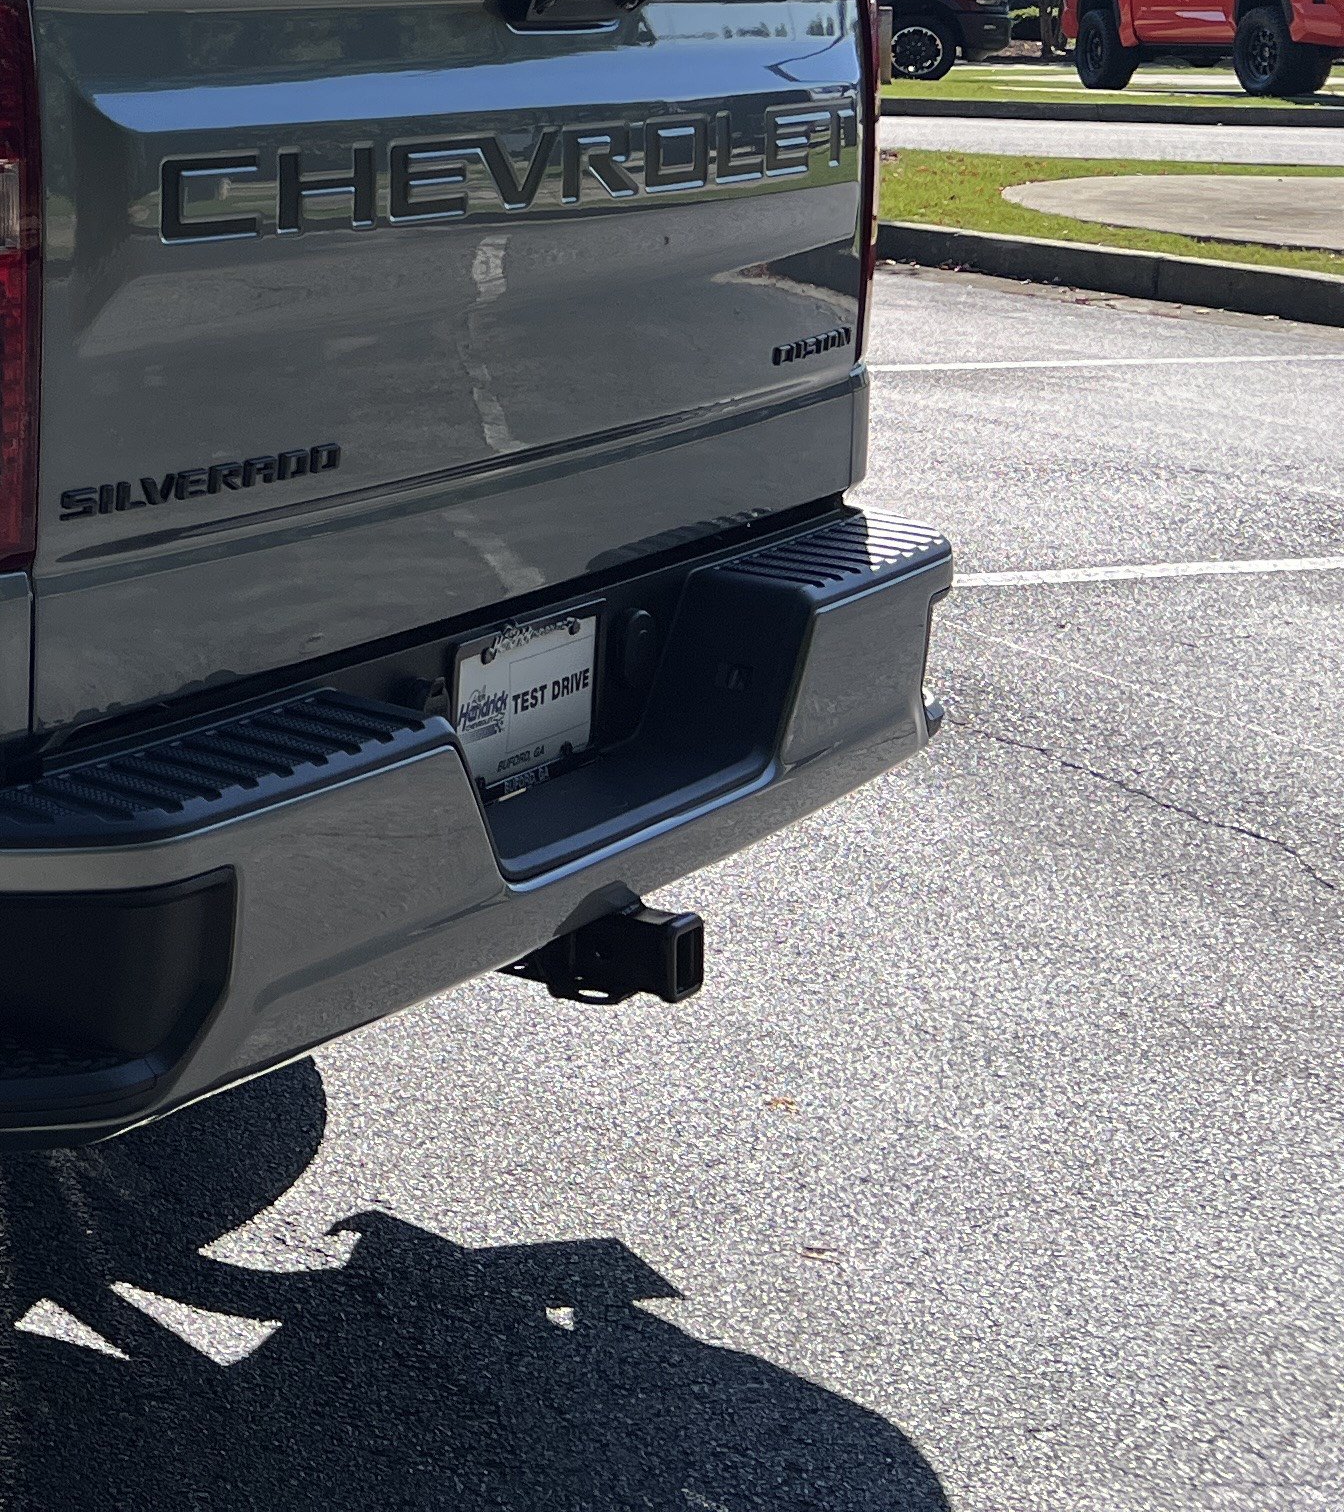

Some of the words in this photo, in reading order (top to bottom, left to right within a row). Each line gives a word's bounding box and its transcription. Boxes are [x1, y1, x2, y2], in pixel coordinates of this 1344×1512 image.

[161, 97, 856, 245] CHEVROLET
[772, 327, 851, 366] CUSTOM
[59, 443, 341, 521] SILVERADO
[457, 690, 509, 731] Hendrick
[512, 683, 548, 715] TEST
[552, 668, 590, 701] DRIVE
[533, 744, 545, 758] GA
